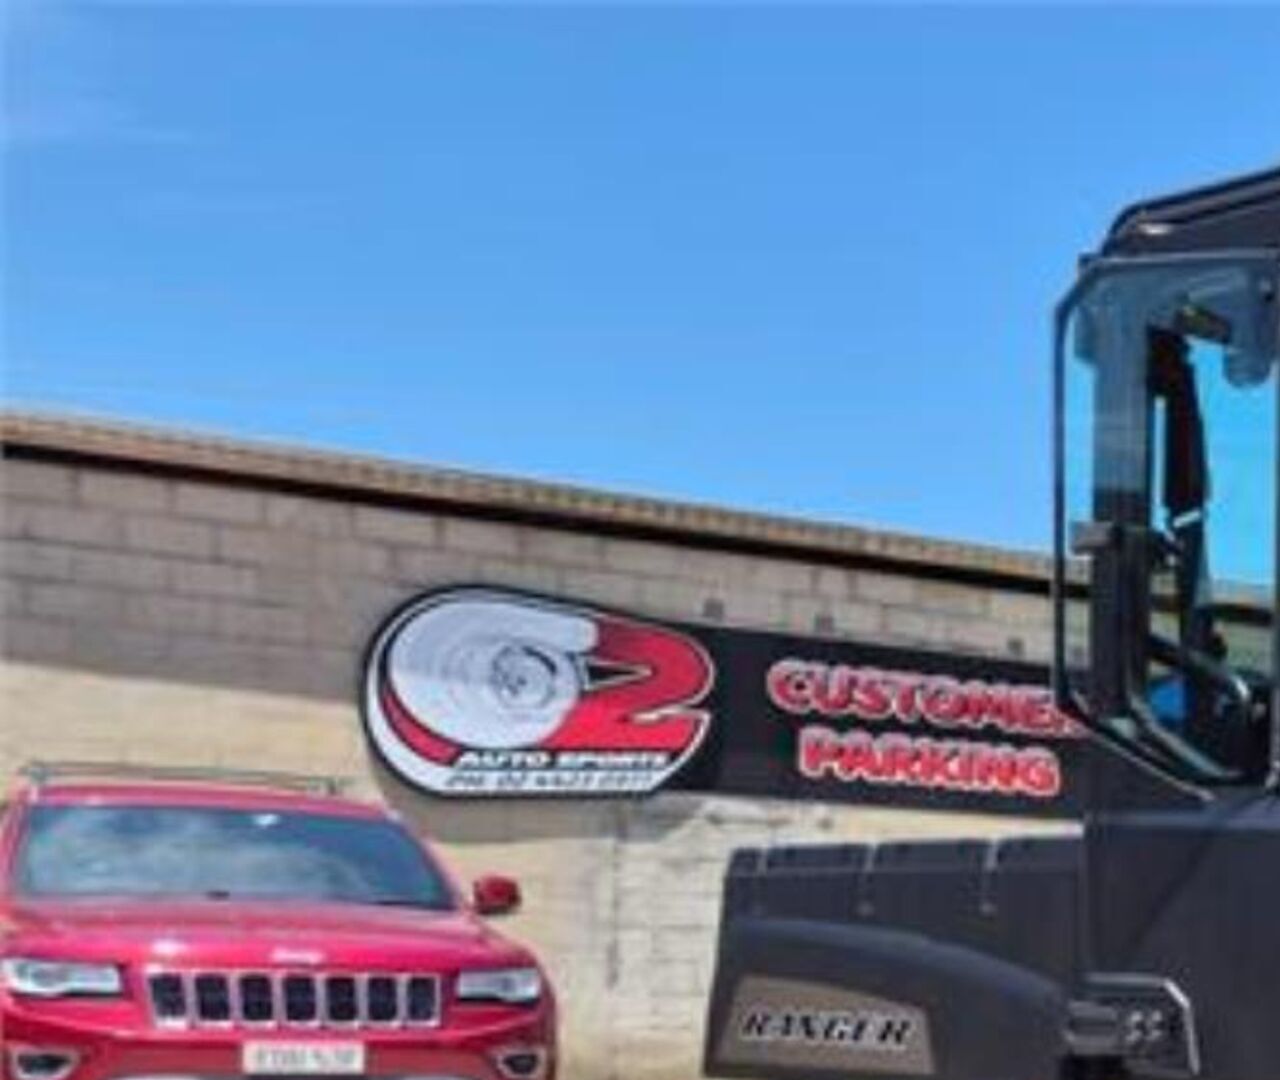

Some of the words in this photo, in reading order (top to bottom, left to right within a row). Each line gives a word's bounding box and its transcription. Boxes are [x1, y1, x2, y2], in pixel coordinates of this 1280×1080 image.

[455, 751, 555, 769] AUTO
[798, 724, 1061, 796] PARKING
[742, 1010, 911, 1043] RANGER
